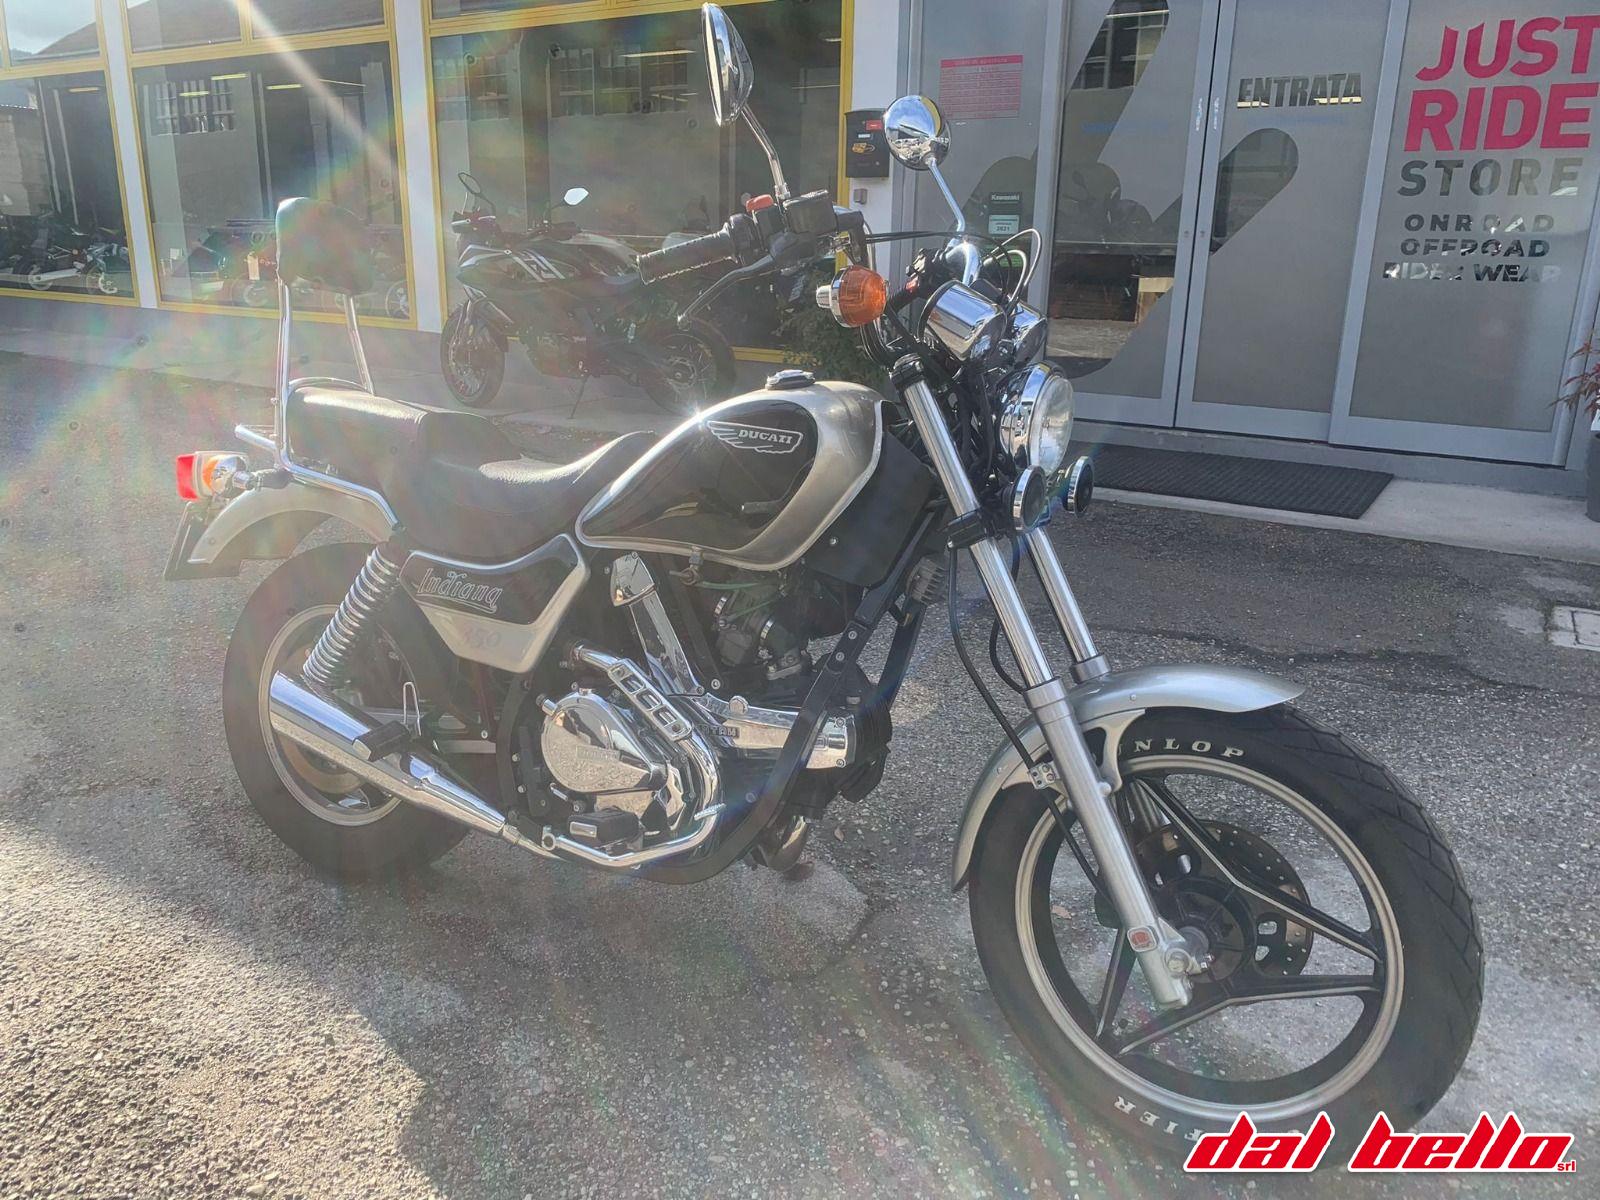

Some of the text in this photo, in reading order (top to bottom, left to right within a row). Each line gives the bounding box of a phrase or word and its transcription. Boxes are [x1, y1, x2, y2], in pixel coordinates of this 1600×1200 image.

[1415, 15, 1600, 81] JUST
[1237, 73, 1362, 109] ENTRATA
[1404, 82, 1600, 152] RIDE
[1398, 157, 1583, 196] STORE
[738, 429, 793, 444] DUCATI
[417, 567, 503, 609] Indiana
[1119, 738, 1244, 758] NLOP
